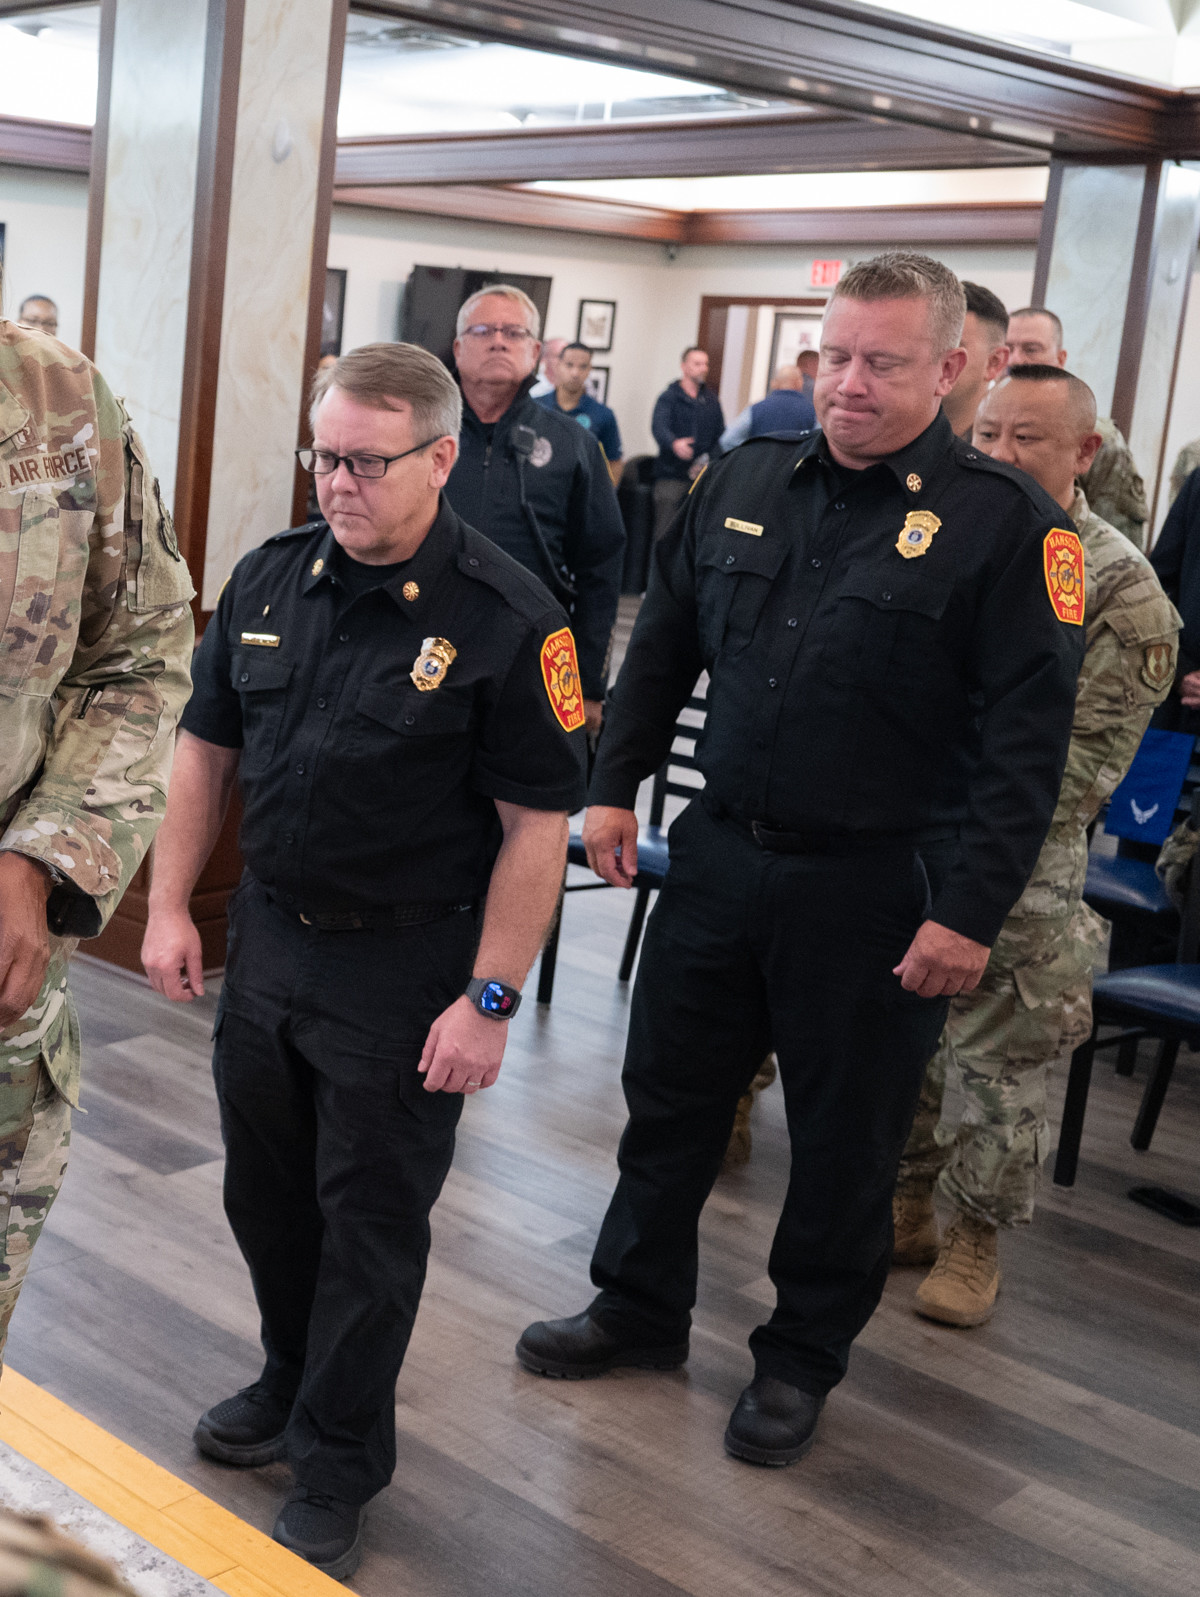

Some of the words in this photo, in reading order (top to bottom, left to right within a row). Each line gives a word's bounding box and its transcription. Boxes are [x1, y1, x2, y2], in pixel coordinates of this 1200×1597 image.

[812, 259, 842, 286] EXIT
[9, 459, 41, 486] AIR
[43, 447, 88, 479] FORCE
[1062, 606, 1078, 620] FIRE
[567, 710, 581, 727] FIRE
